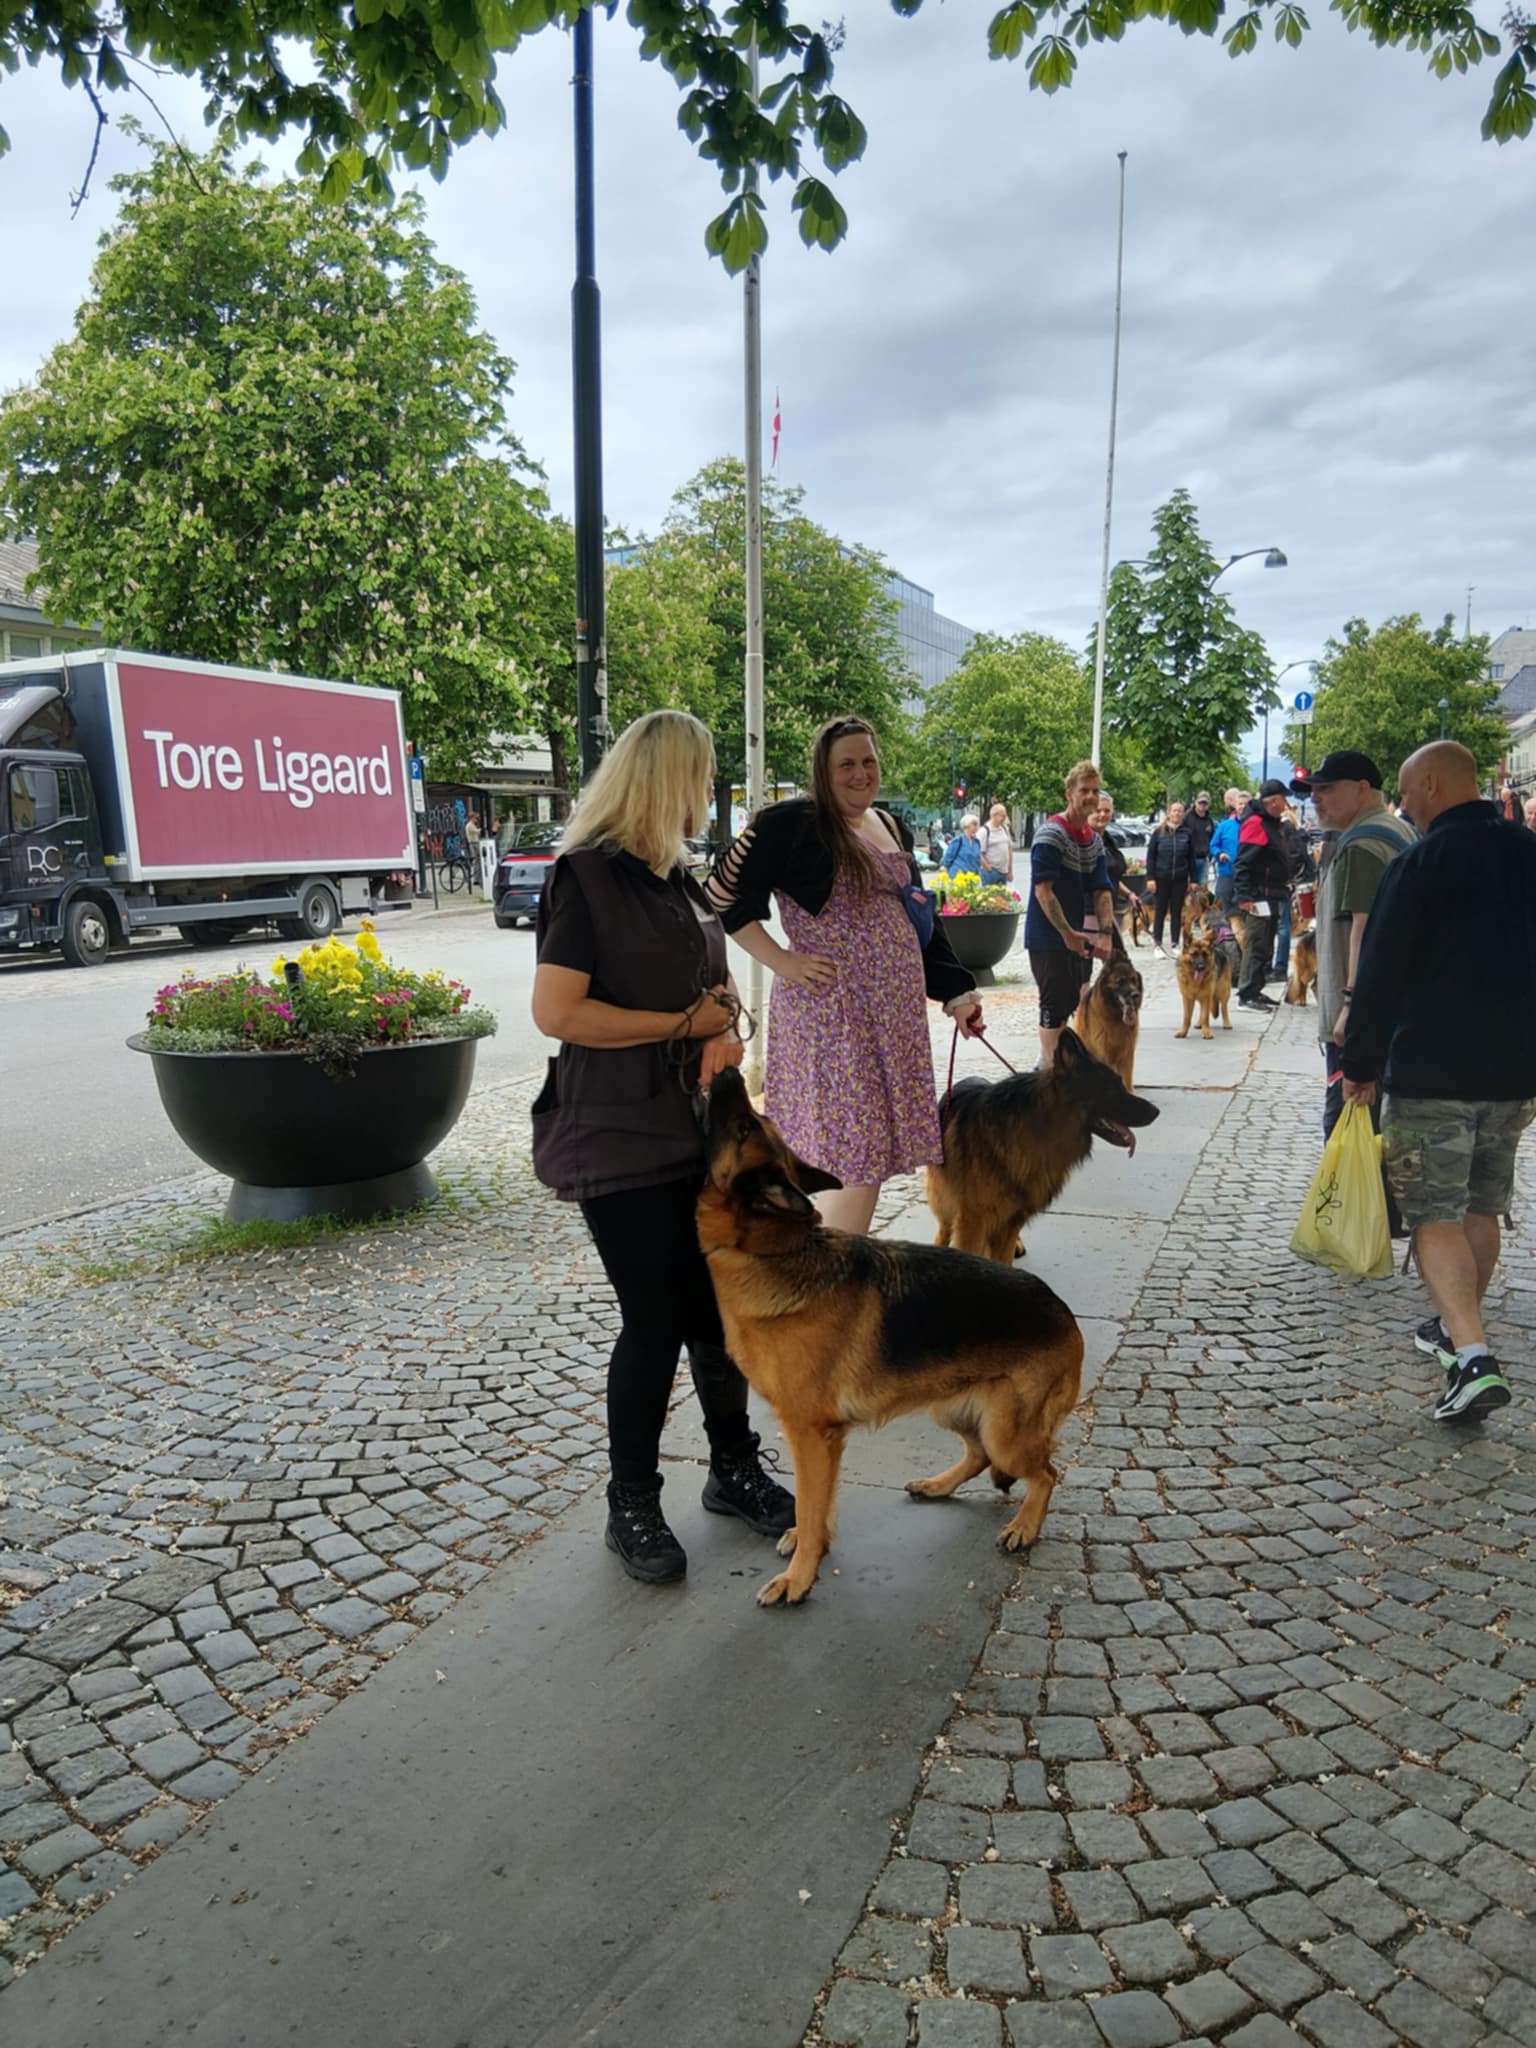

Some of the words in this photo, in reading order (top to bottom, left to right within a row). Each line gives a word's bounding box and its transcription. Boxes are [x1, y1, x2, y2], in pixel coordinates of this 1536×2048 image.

[143, 730, 244, 791] Tore
[254, 736, 393, 809] Ligaard
[411, 761, 419, 777] P
